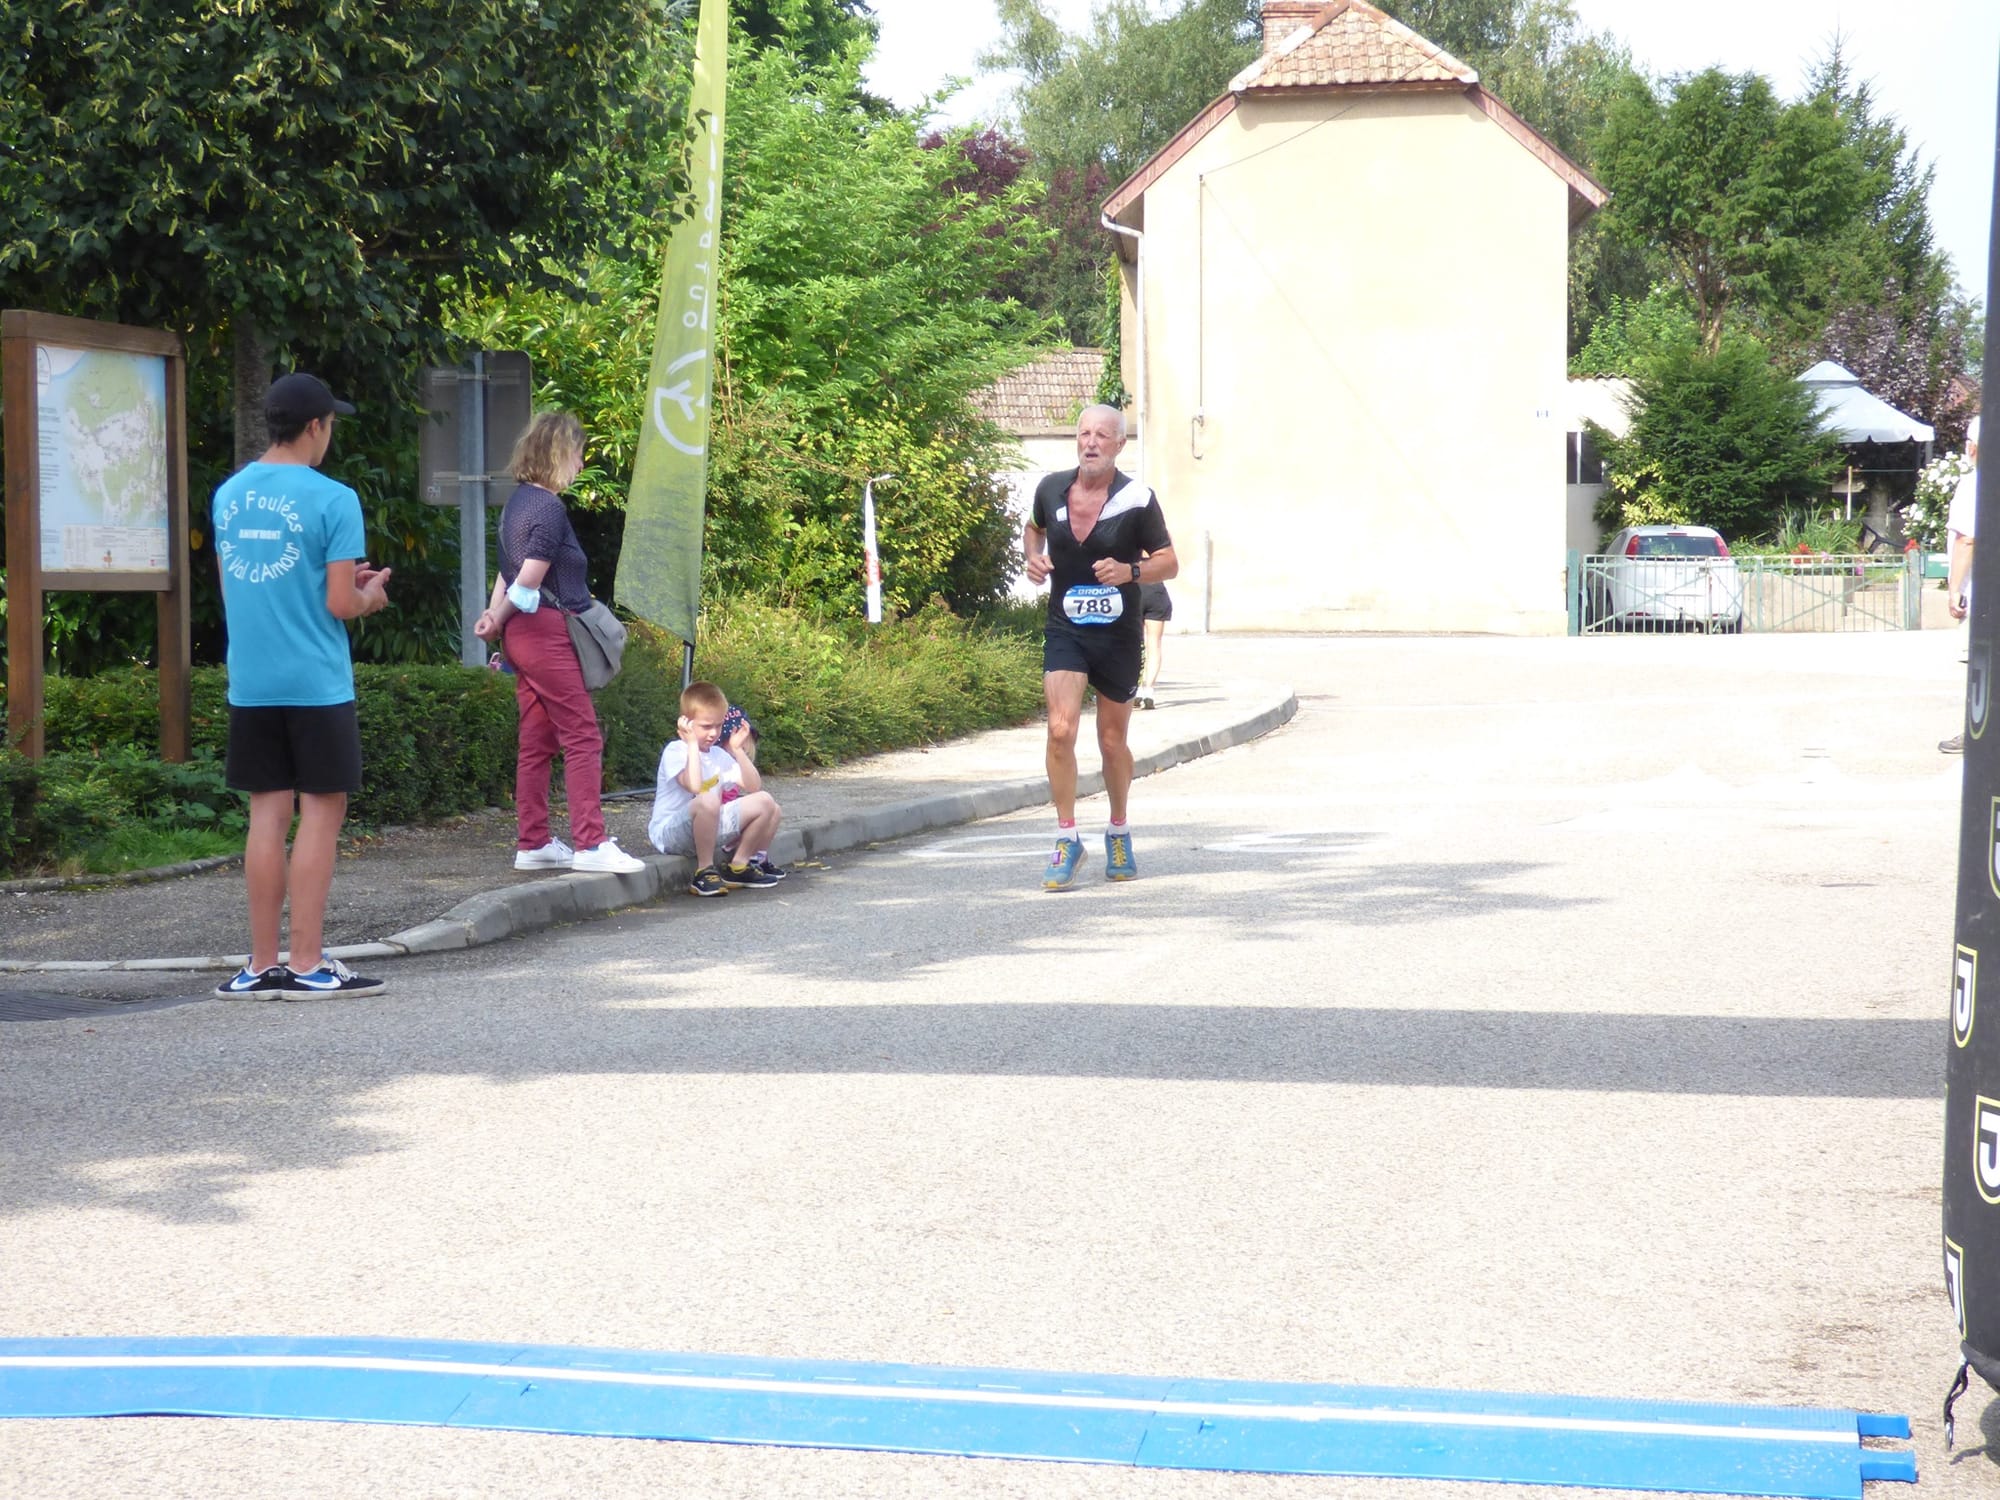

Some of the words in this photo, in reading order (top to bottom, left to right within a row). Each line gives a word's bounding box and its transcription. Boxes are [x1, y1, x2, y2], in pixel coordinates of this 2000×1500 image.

[218, 501, 239, 531] Les
[246, 490, 303, 532] Foulées
[228, 555, 249, 580] Val
[1073, 598, 1112, 614] 788
